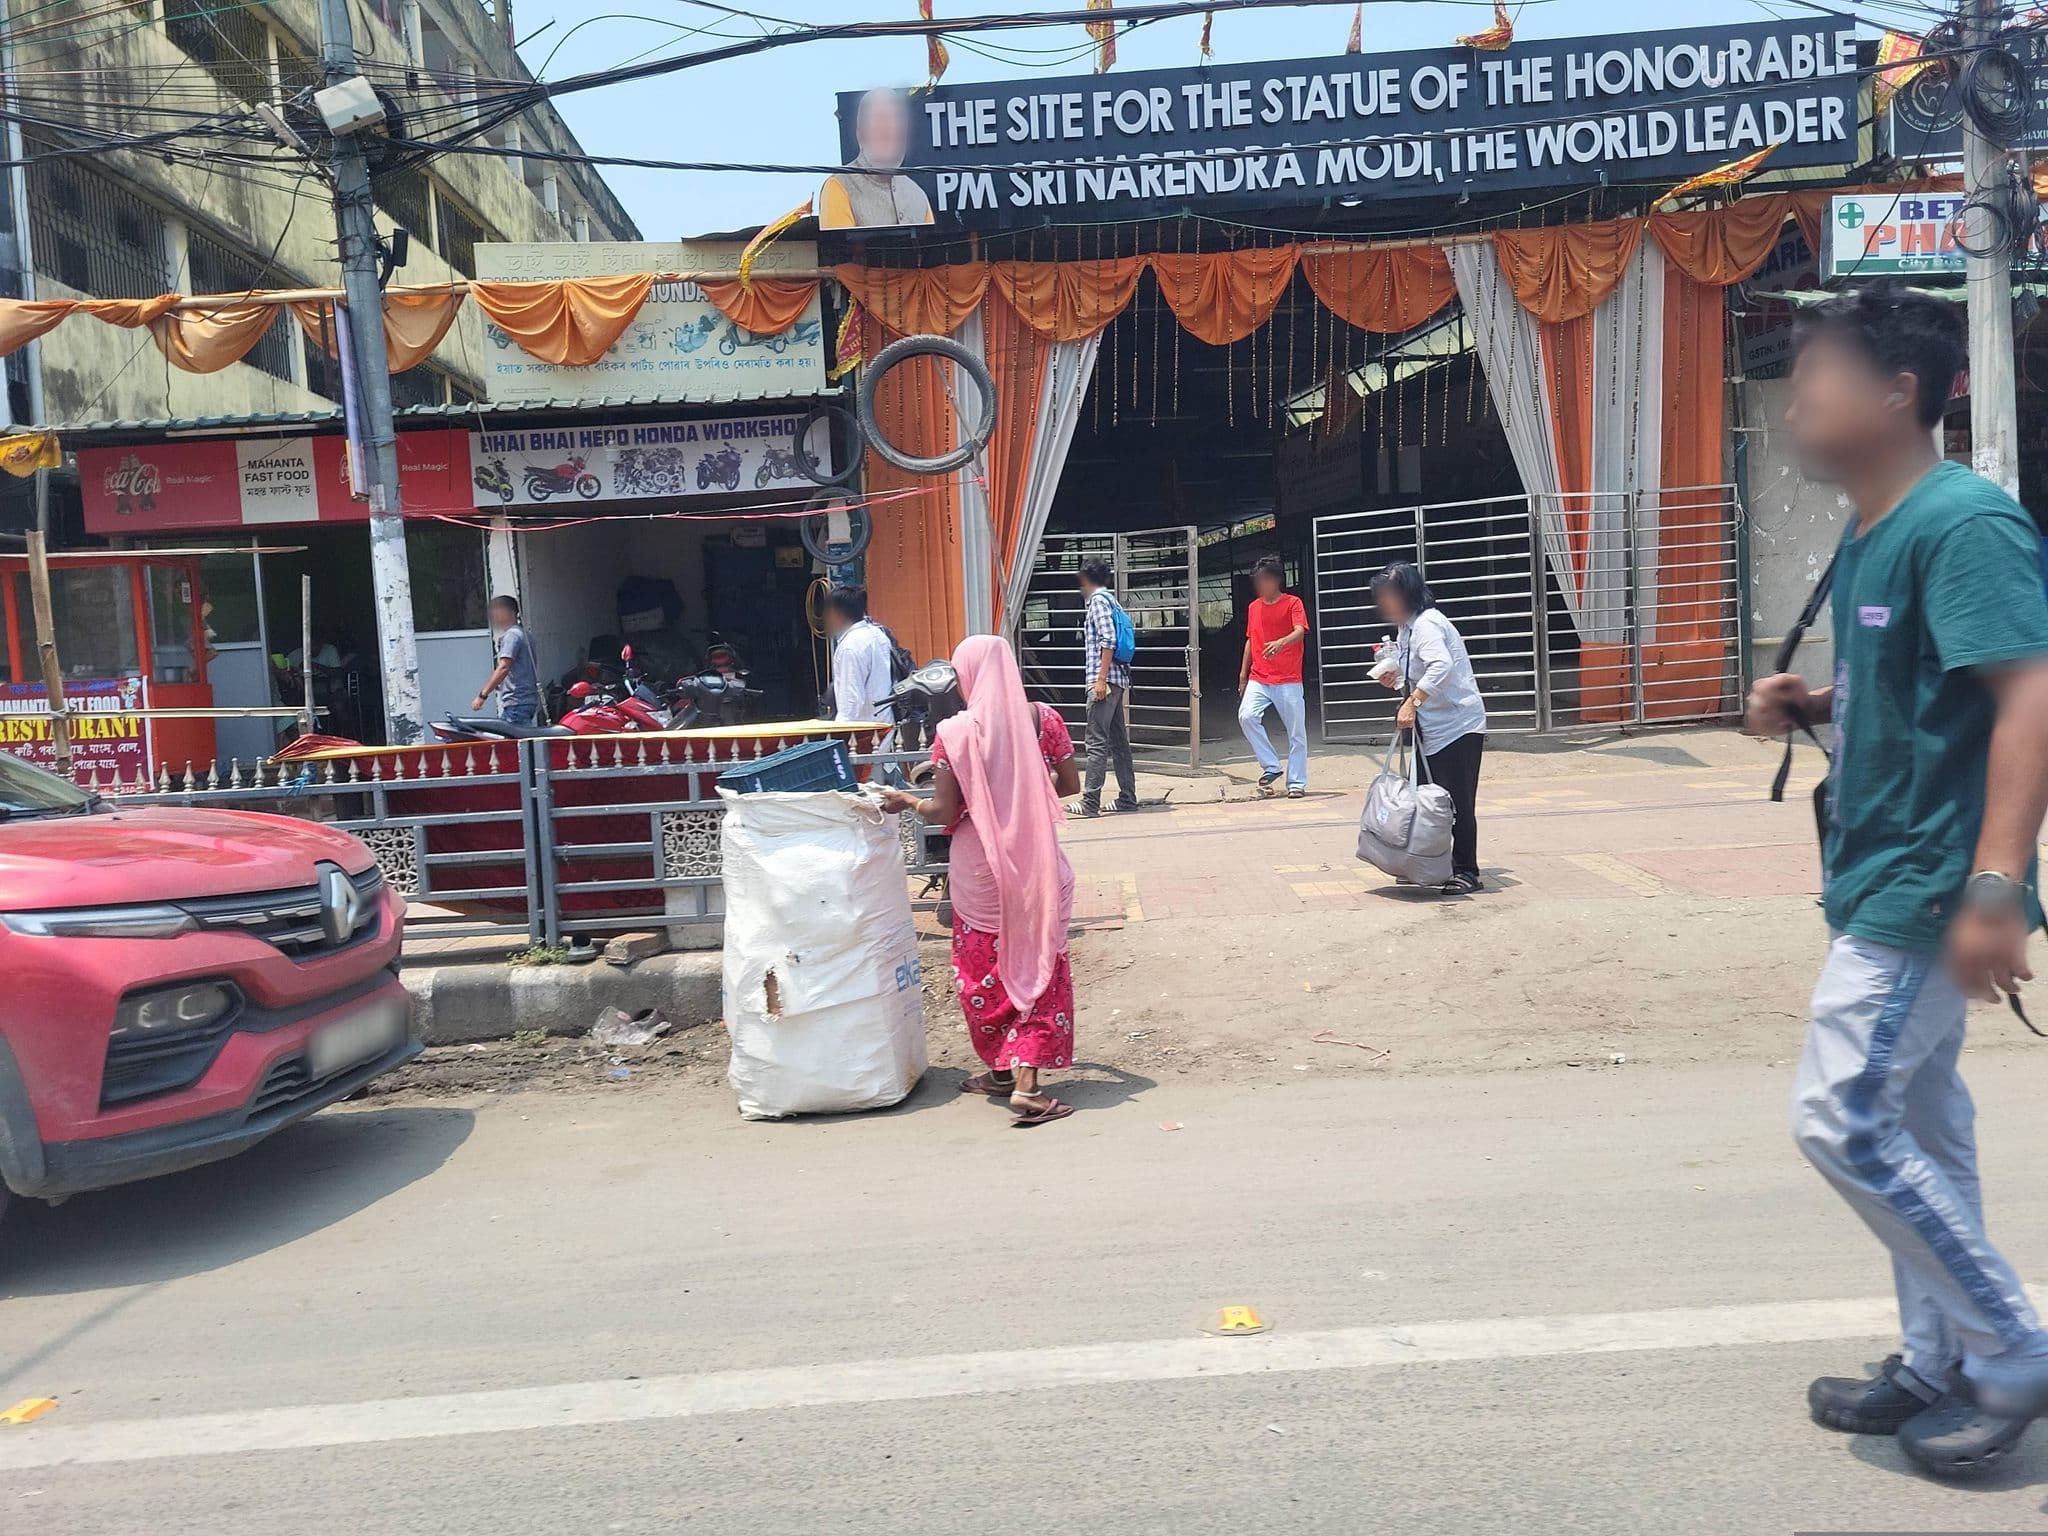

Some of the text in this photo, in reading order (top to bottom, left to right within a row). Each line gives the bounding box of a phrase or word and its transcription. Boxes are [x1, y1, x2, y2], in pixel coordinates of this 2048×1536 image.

[926, 98, 998, 147] THE
[1006, 92, 1084, 142] SITE
[1093, 88, 1174, 137] FOR
[1181, 80, 1252, 129] THE
[1260, 69, 1400, 124] STATUE
[1409, 63, 1468, 112] OF
[1481, 56, 1552, 105] THE
[1566, 30, 1857, 99] HONOURABLE
[936, 165, 999, 211] PM
[1009, 162, 1067, 207] SRI
[1076, 143, 1306, 203] NARENDRA
[1527, 111, 1678, 167] WORLD
[1685, 96, 1848, 154] LEADER
[530, 432, 575, 451] BHAI
[634, 423, 699, 446] HONDA
[245, 470, 310, 483] FAST FOOD
[247, 458, 305, 470] MAHANTA
[401, 462, 449, 473] Real Magic
[0, 717, 140, 742] RESTURANT
